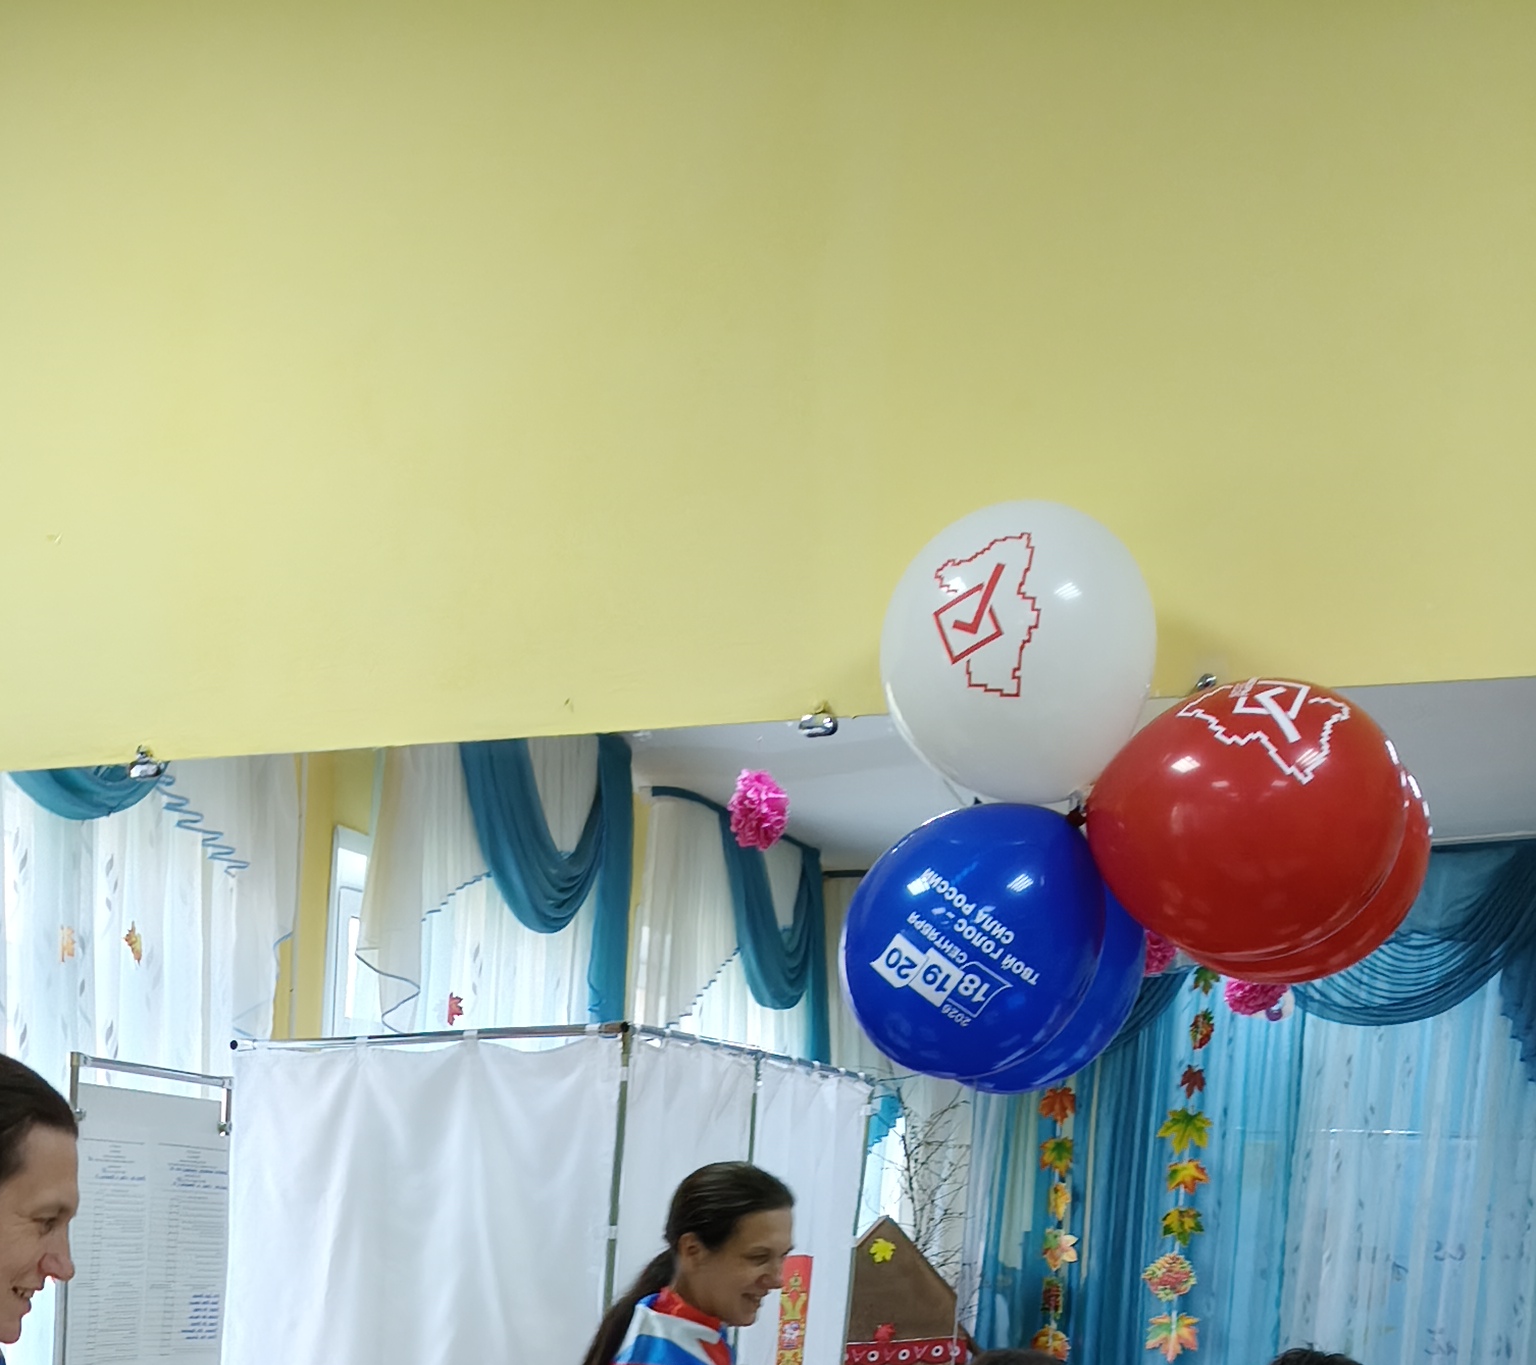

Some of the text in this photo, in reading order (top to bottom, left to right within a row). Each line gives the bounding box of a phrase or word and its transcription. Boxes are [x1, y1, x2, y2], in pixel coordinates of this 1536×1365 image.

[907, 911, 968, 964] СЕНТЯБРЯ
[954, 918, 1004, 960] ГОЛОС
[885, 947, 991, 1003] 18 19 20
[1001, 954, 1041, 986] ТВОЙ
